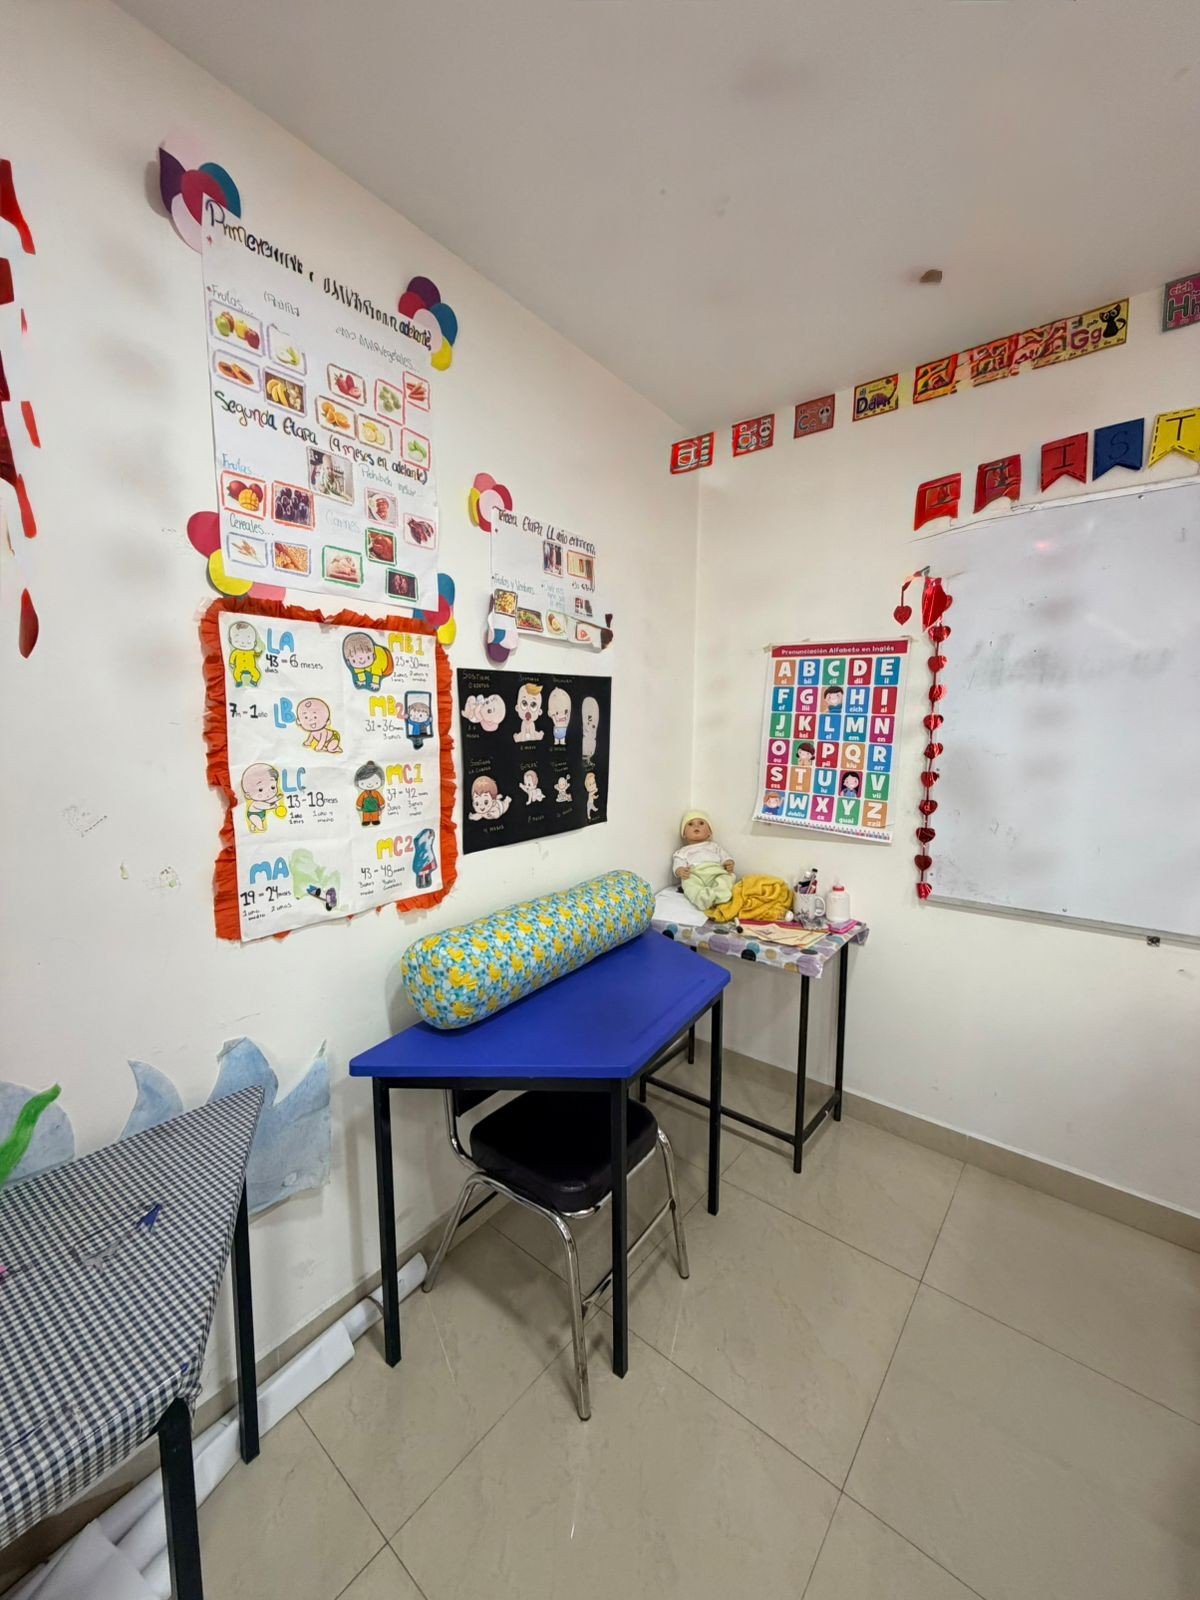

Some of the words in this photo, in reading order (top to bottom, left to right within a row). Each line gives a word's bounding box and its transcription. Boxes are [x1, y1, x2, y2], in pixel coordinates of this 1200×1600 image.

[215, 391, 277, 430] Segunda
[267, 628, 295, 654] LA
[388, 632, 424, 657] MB1
[829, 646, 860, 654] Alfabeto
[778, 662, 791, 677] A
[803, 661, 815, 677] B
[827, 660, 840, 676] C
[853, 660, 867, 676] D
[880, 659, 894, 676] E
[368, 694, 405, 720] MB2
[777, 689, 789, 704] F
[800, 689, 813, 704] G
[850, 689, 865, 705] H
[881, 689, 888, 706] I
[273, 697, 298, 729] LB
[776, 715, 786, 730] J
[798, 716, 812, 731] K
[824, 716, 835, 732] L
[846, 717, 864, 733] M
[874, 718, 890, 734] N
[771, 740, 786, 756] O
[822, 743, 834, 758] P
[845, 744, 861, 763] Q
[872, 746, 887, 762] R
[386, 763, 423, 785] MC1
[770, 767, 783, 782] S
[795, 768, 806, 784] T
[818, 770, 832, 787] U
[870, 774, 886, 791] V
[789, 794, 807, 810] W
[815, 797, 829, 813] X
[842, 799, 856, 815] Y
[867, 802, 882, 819] Z
[376, 836, 413, 860] MC2
[250, 857, 290, 885] MA
